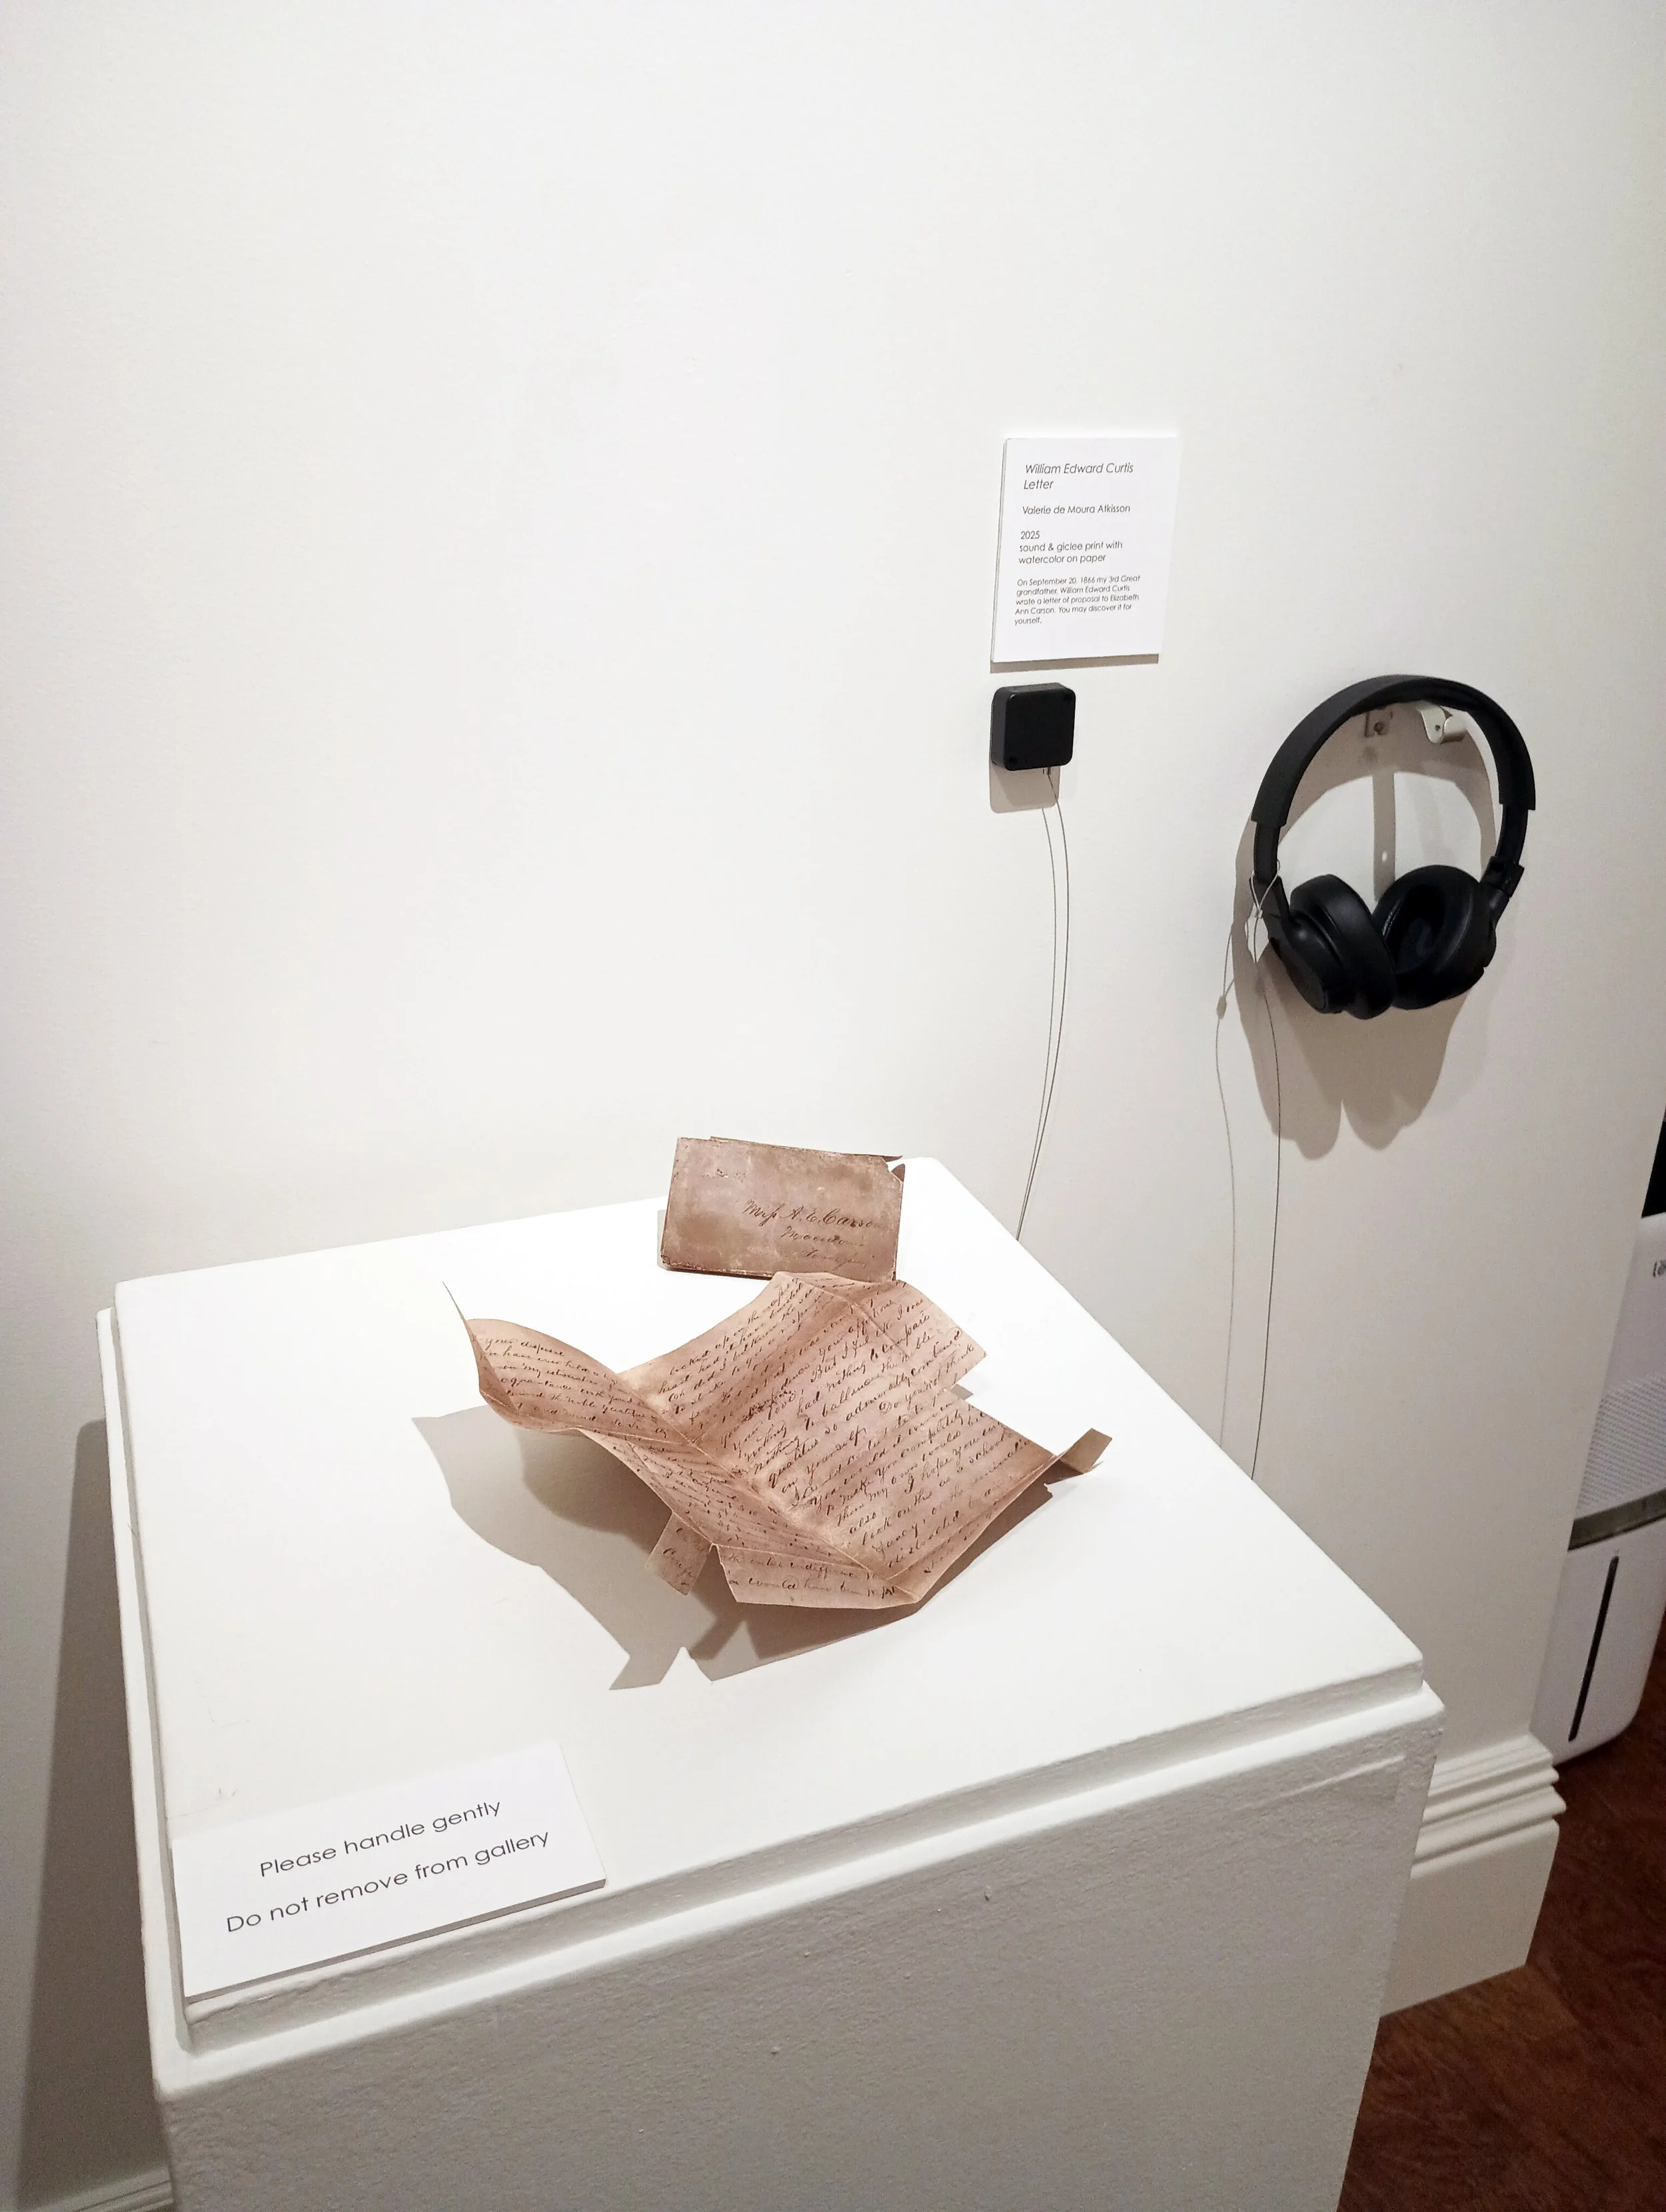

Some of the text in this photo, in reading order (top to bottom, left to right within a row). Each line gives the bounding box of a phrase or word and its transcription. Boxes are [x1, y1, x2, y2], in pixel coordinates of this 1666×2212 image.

[1025, 462, 1134, 474] William Edward Curtis
[1024, 480, 1054, 490] Letter
[1023, 506, 1051, 514] Valerie
[1068, 505, 1095, 514] Moura
[1098, 504, 1130, 513] Atkisson
[1020, 531, 1040, 540] 2025
[1020, 543, 1045, 552] sound
[1057, 542, 1083, 552] giclee
[1085, 542, 1104, 551] print
[1019, 555, 1064, 564] watercolor
[1080, 554, 1106, 564] paper
[1029, 578, 1067, 586] September
[1071, 595, 1100, 604] proposal
[1014, 616, 1042, 626] yourself.
[260, 1802, 501, 1878] Please handle gently
[227, 1832, 549, 1932] Do not remove from gallery
